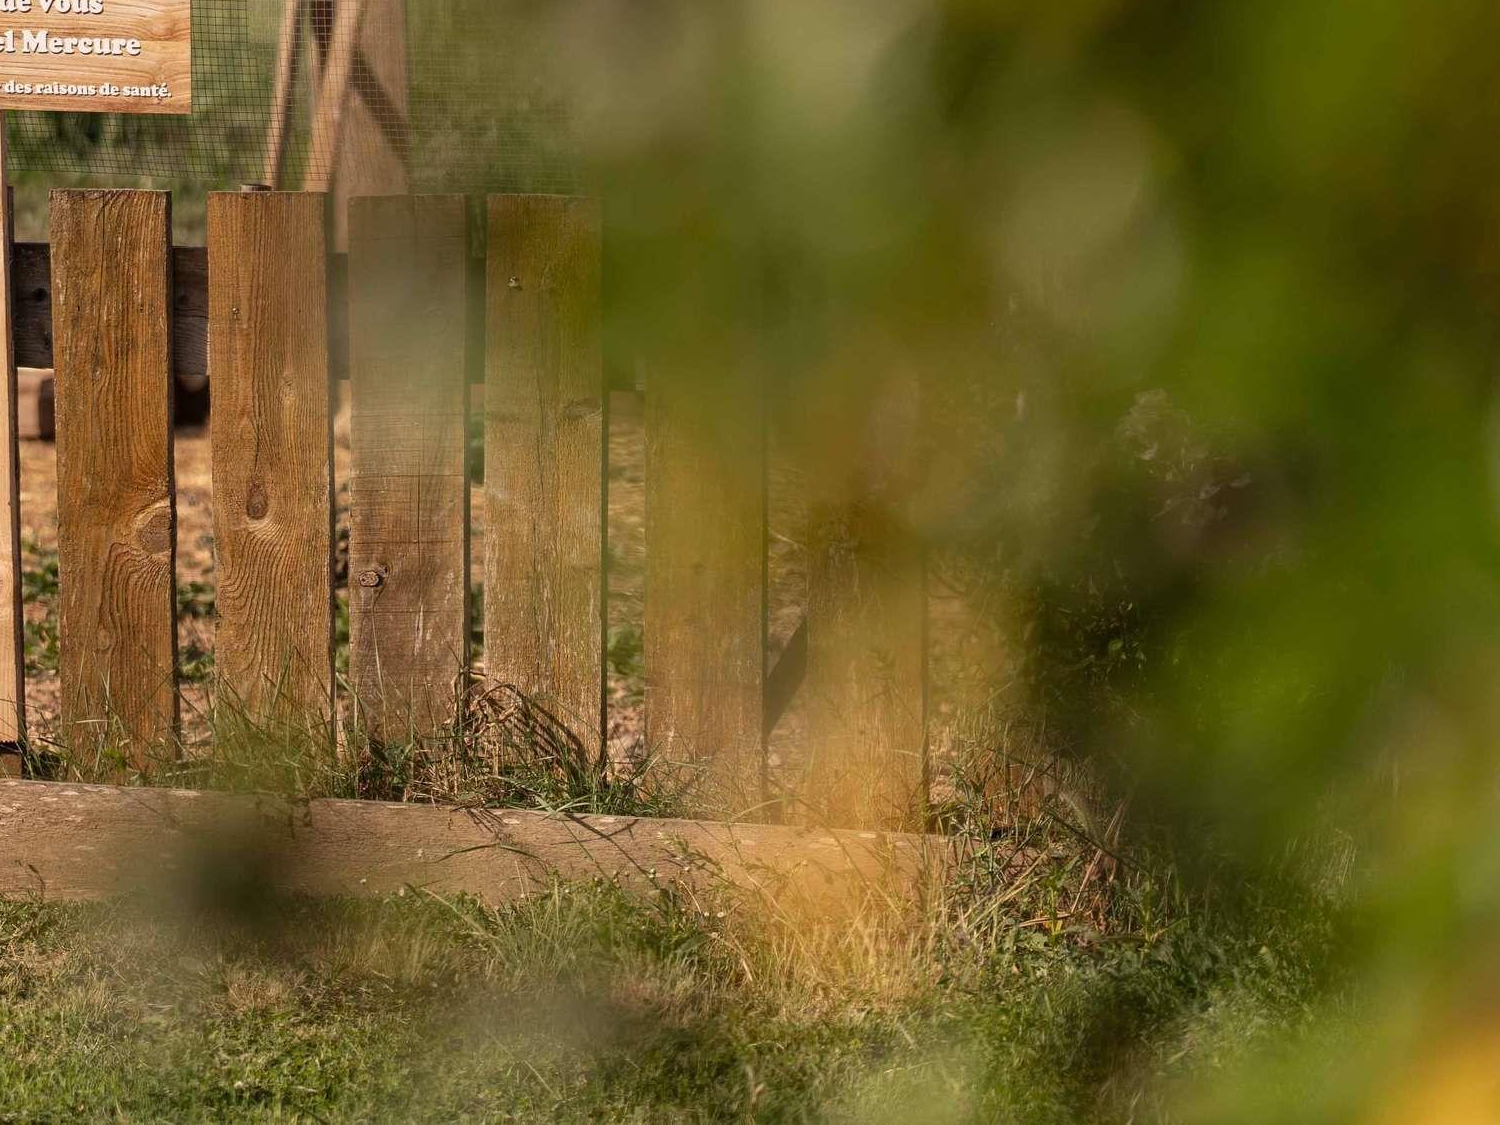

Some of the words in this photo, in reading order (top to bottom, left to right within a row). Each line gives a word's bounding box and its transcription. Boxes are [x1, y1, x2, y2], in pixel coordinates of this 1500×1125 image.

[21, 30, 141, 56] Mercure
[4, 80, 32, 95] des
[36, 82, 96, 96] raisons
[99, 82, 119, 97] de
[122, 83, 172, 98] santé.
